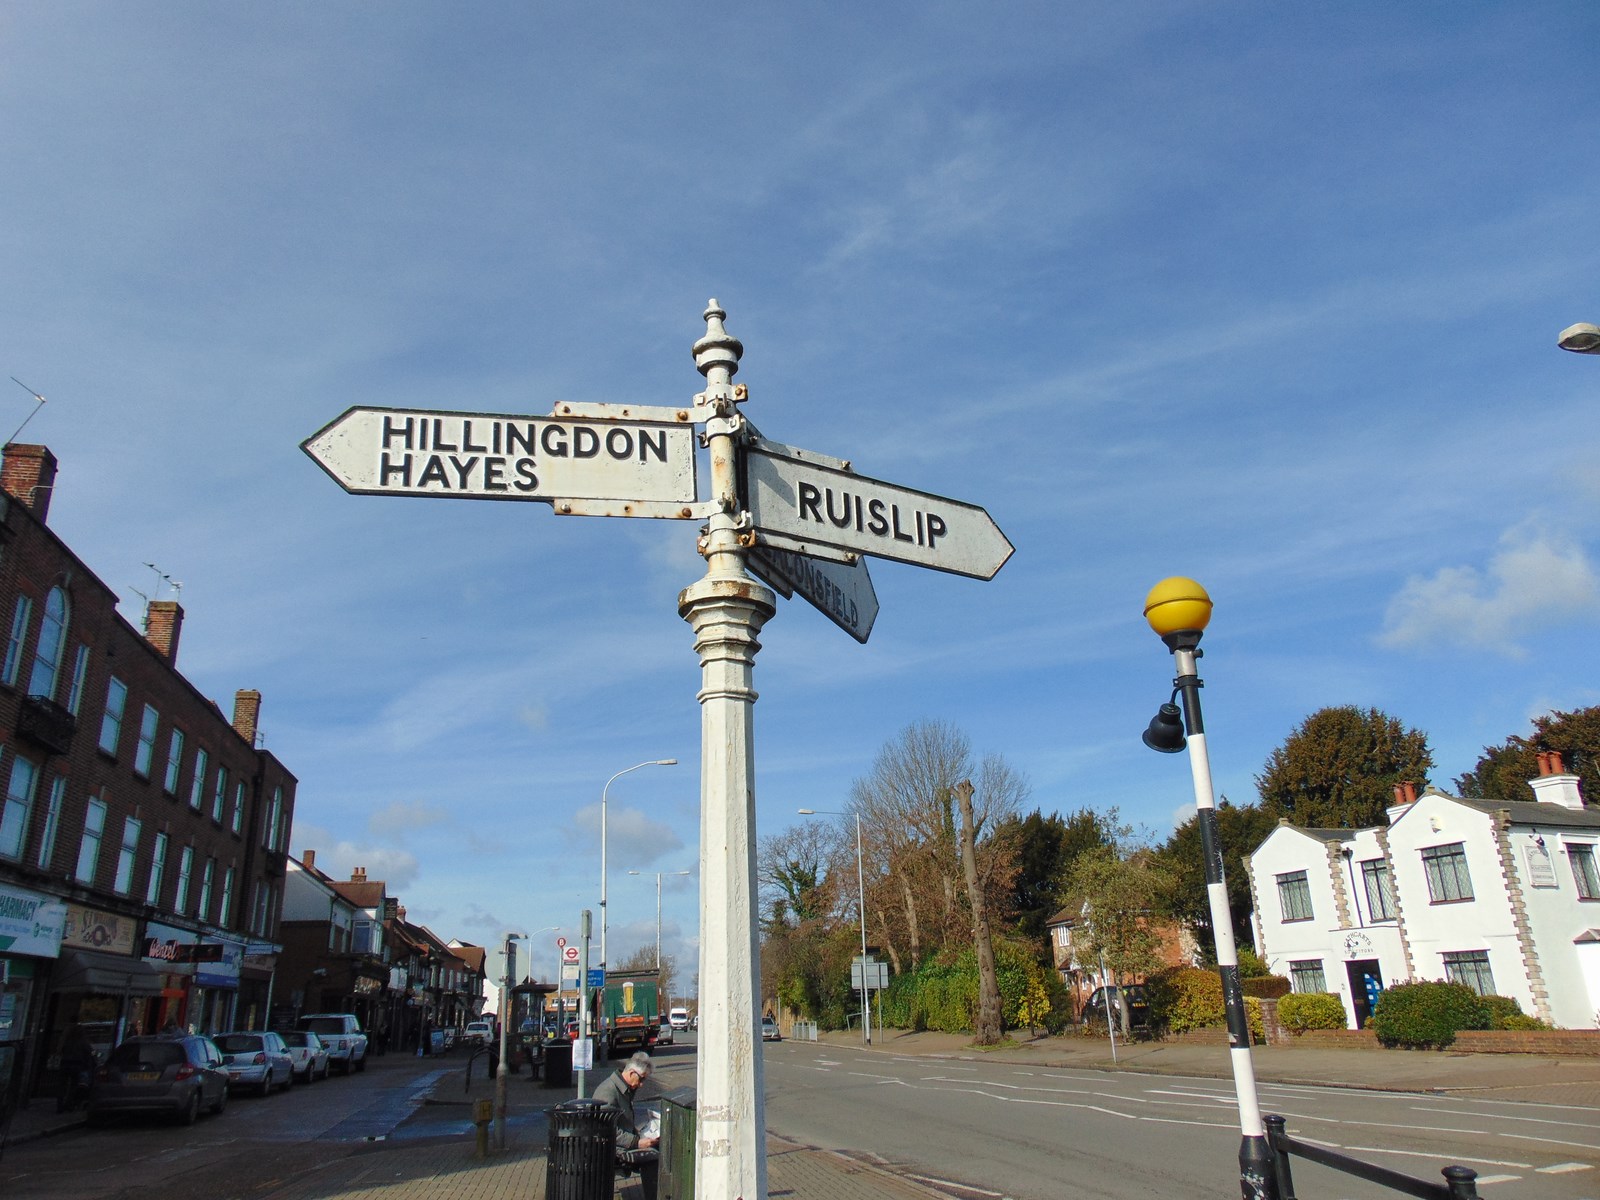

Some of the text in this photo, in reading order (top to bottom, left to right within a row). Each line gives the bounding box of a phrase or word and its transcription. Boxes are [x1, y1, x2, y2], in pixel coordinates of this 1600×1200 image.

[383, 416, 667, 462] HILLINGDON
[380, 452, 538, 491] HAYES
[798, 481, 946, 548] RUISLIP
[0, 895, 39, 922] HARMACY
